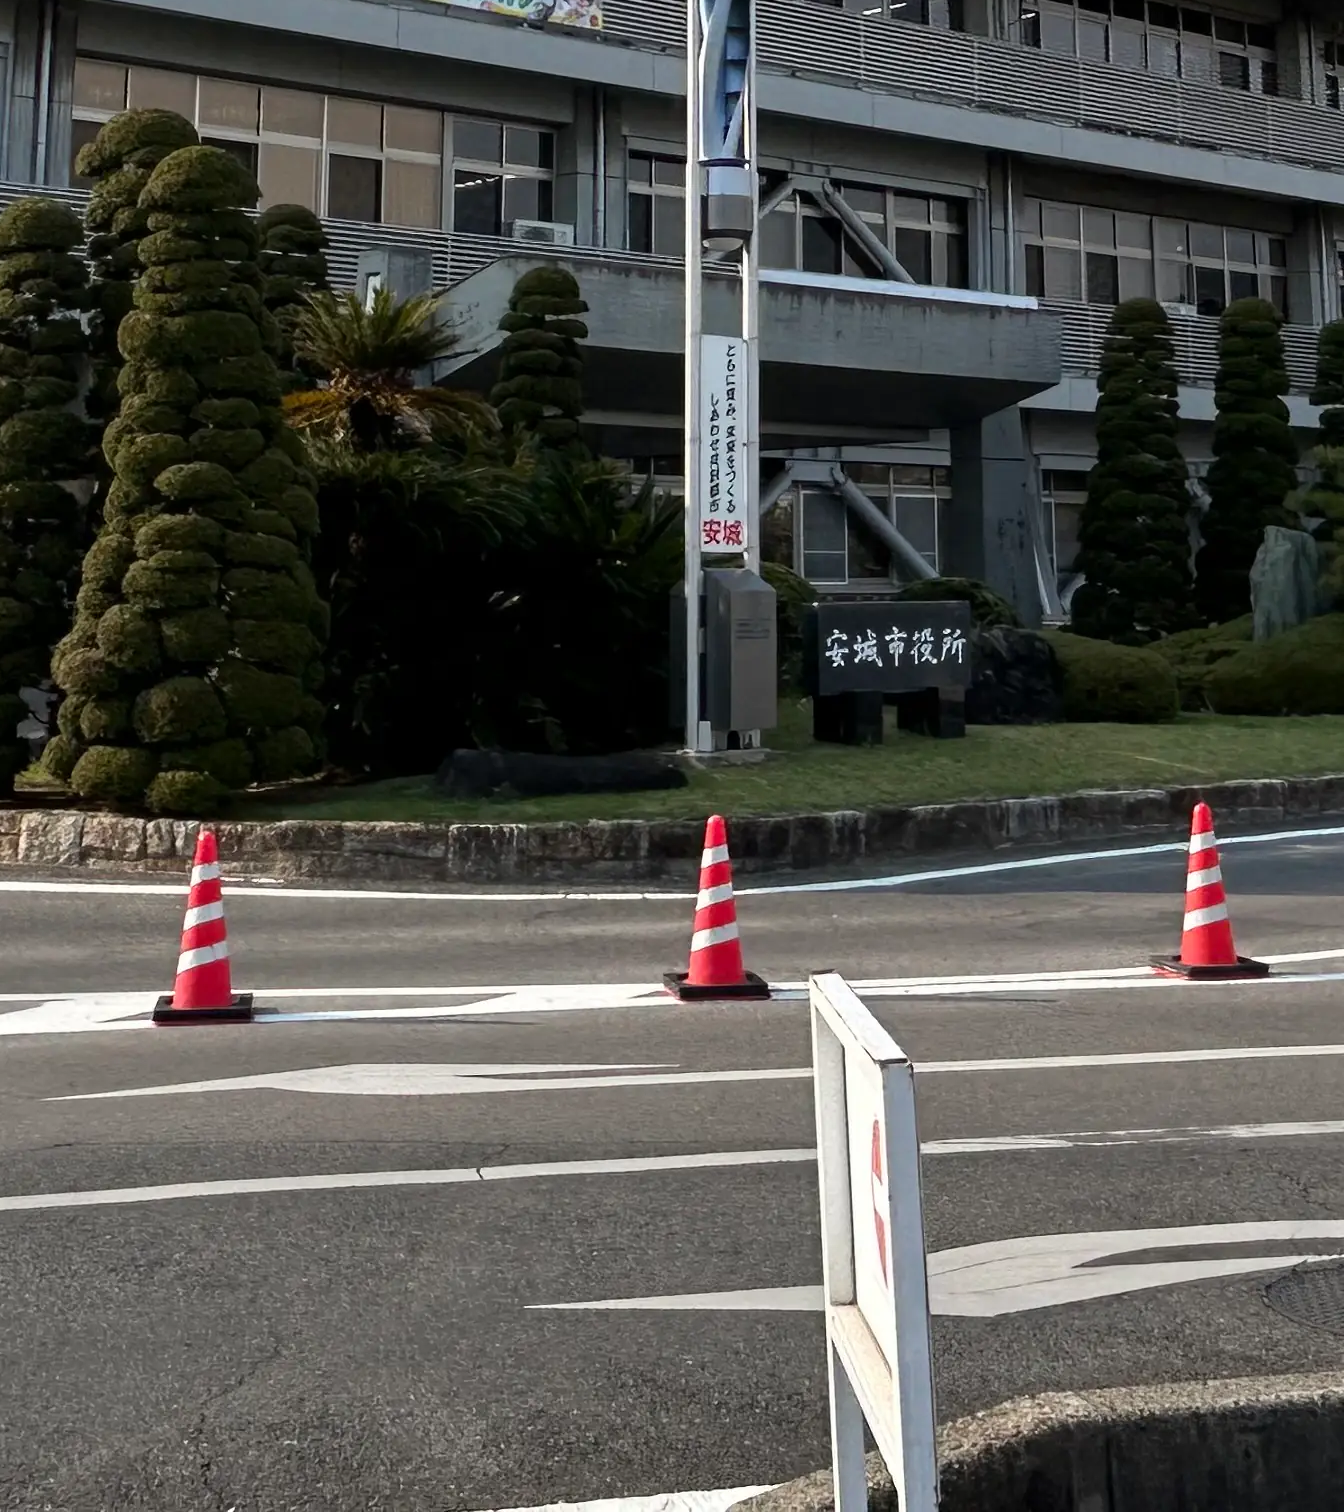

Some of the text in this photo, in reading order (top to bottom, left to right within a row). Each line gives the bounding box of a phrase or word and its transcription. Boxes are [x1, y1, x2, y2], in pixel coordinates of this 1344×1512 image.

[825, 626, 966, 667] 安城市役所
